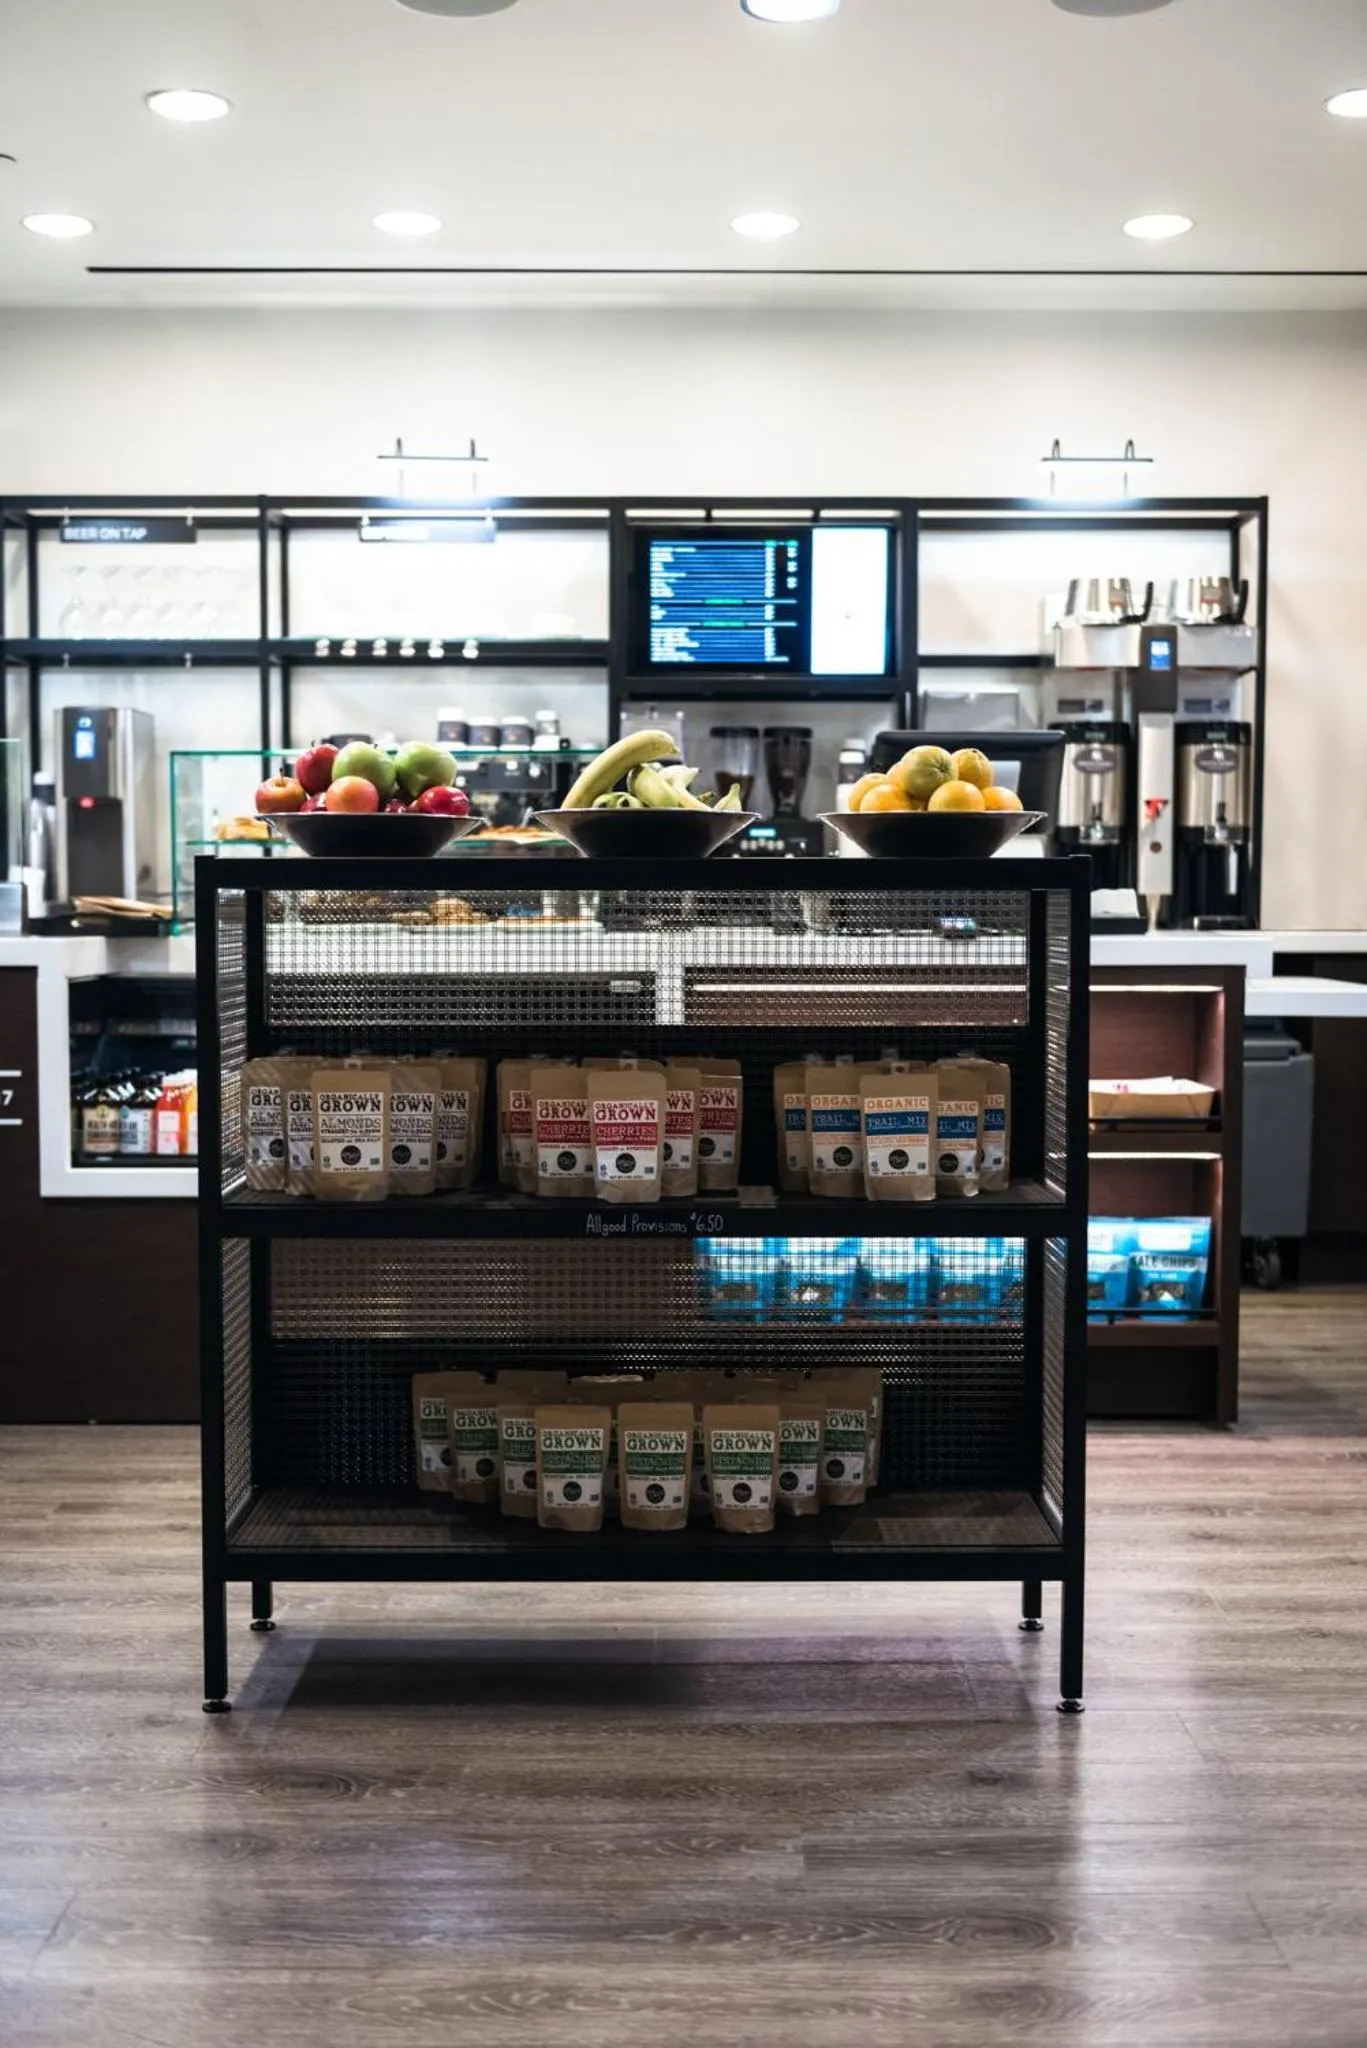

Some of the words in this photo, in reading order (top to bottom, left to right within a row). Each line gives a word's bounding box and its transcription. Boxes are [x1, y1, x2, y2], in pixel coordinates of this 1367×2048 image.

[64, 527, 96, 540] BEER
[100, 527, 120, 540] ON
[122, 527, 148, 540] TAP
[320, 1100, 381, 1112] GROWN
[867, 1098, 927, 1109] ORGANIC
[596, 1109, 656, 1120] GROWN
[320, 1118, 381, 1129] ALMONDS
[867, 1117, 900, 1126] TRAIL
[907, 1116, 927, 1125] MIX
[596, 1126, 657, 1136] CHERRIES
[586, 1213, 627, 1237] Allgood
[631, 1213, 688, 1233] Provisions
[543, 1437, 601, 1449] GROWN
[627, 1439, 684, 1450] GROWN
[713, 1438, 771, 1450] GROWN
